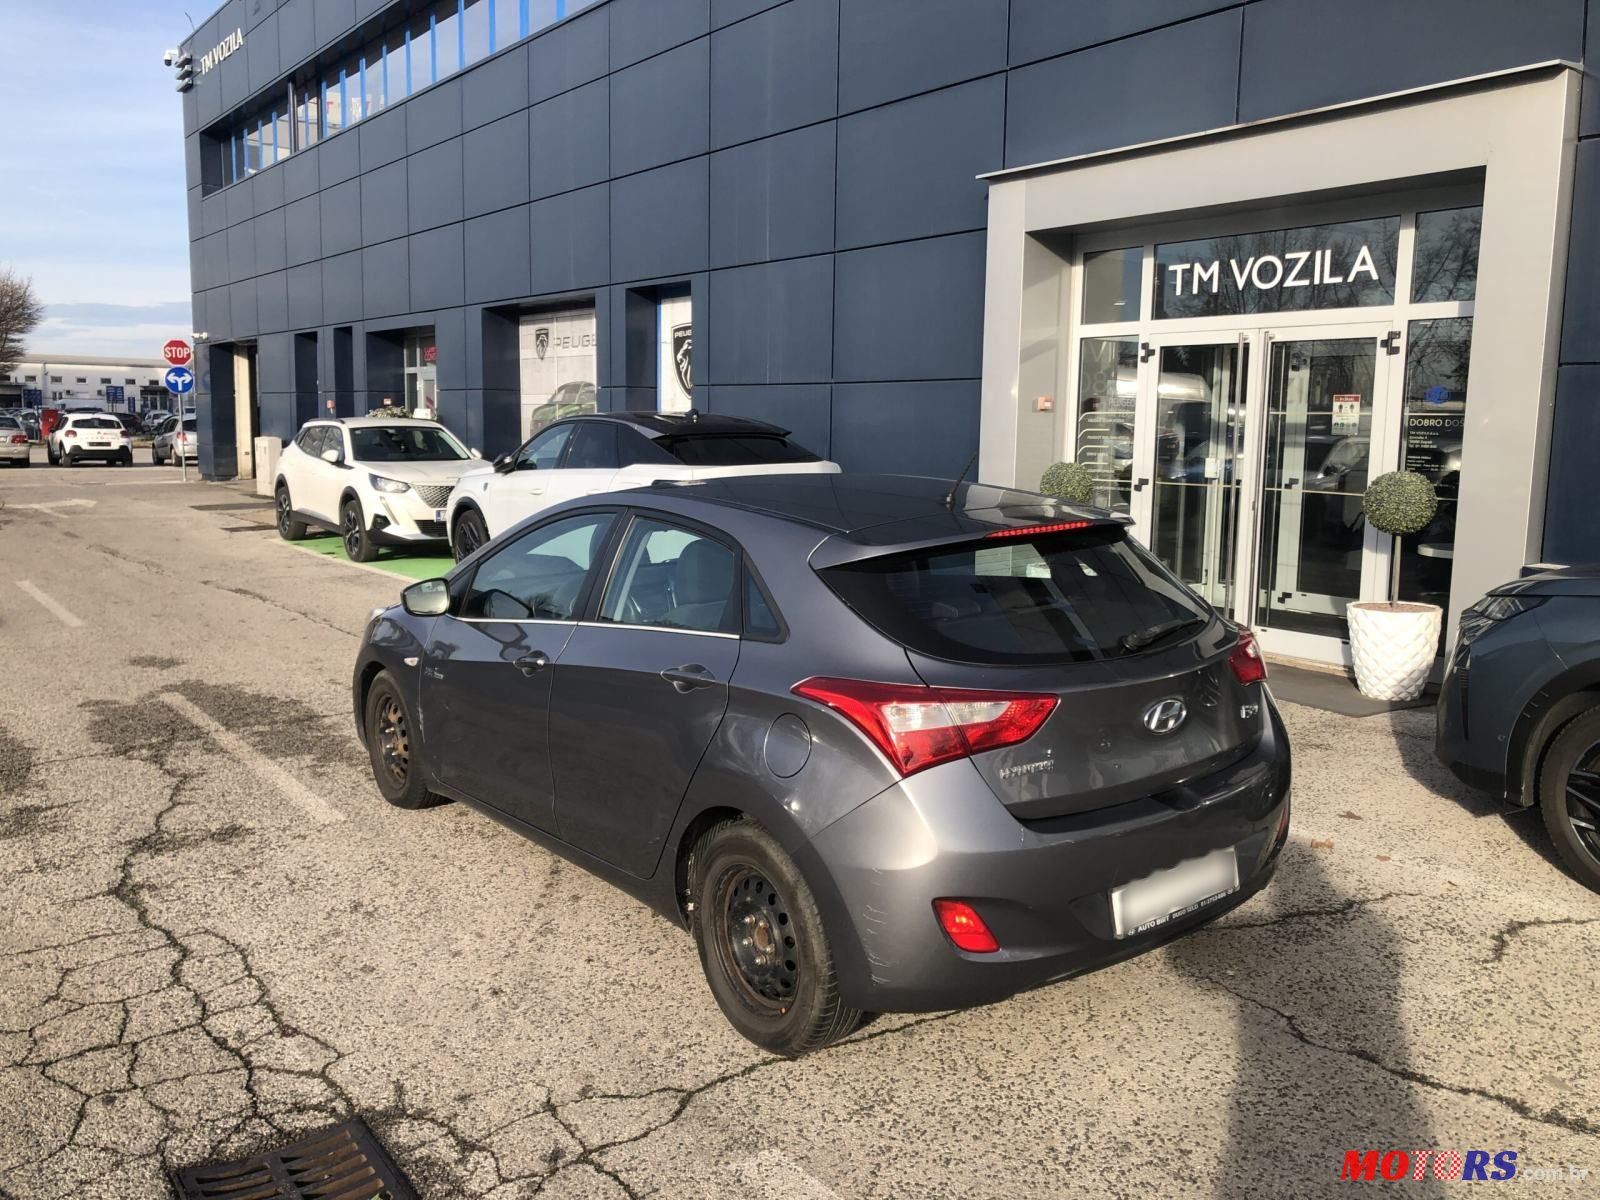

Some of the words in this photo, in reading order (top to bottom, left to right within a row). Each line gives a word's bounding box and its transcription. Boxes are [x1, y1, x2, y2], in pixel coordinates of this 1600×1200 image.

[200, 51, 213, 75] TM
[213, 27, 244, 65] VOZILA
[1168, 260, 1220, 296] TM
[1230, 245, 1379, 291] VOZILA
[164, 347, 191, 358] STOP
[1410, 418, 1443, 427] DOBRO
[1138, 920, 1156, 933] AUTO
